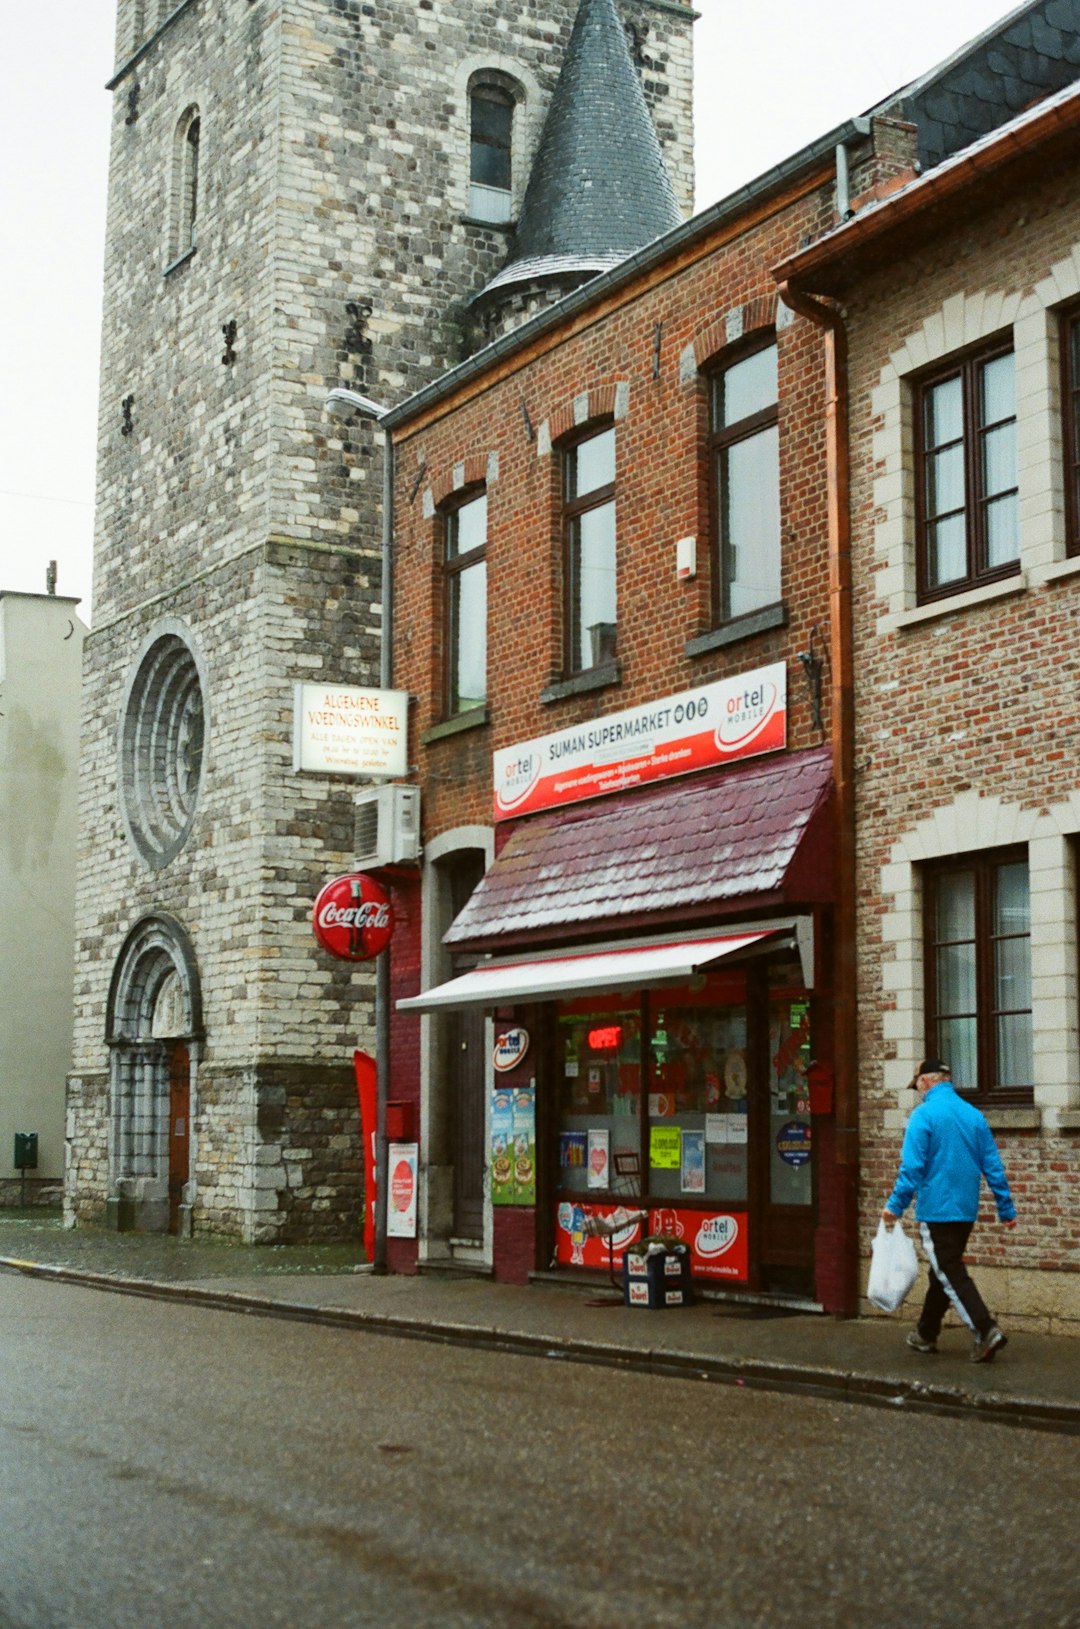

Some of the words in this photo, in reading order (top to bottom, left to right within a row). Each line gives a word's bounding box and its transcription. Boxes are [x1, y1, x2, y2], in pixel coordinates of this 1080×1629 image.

[324, 694, 379, 711] ALGEMENE
[727, 684, 763, 713] ortel
[308, 711, 400, 730] VOEDINGSWINKEL
[728, 707, 763, 724] MOBILE
[549, 737, 586, 760] SUMAN
[587, 709, 672, 749] SUPERMARKET
[505, 754, 532, 777] ortel
[319, 902, 390, 928] Coca-Cola
[703, 1220, 728, 1233] ortel
